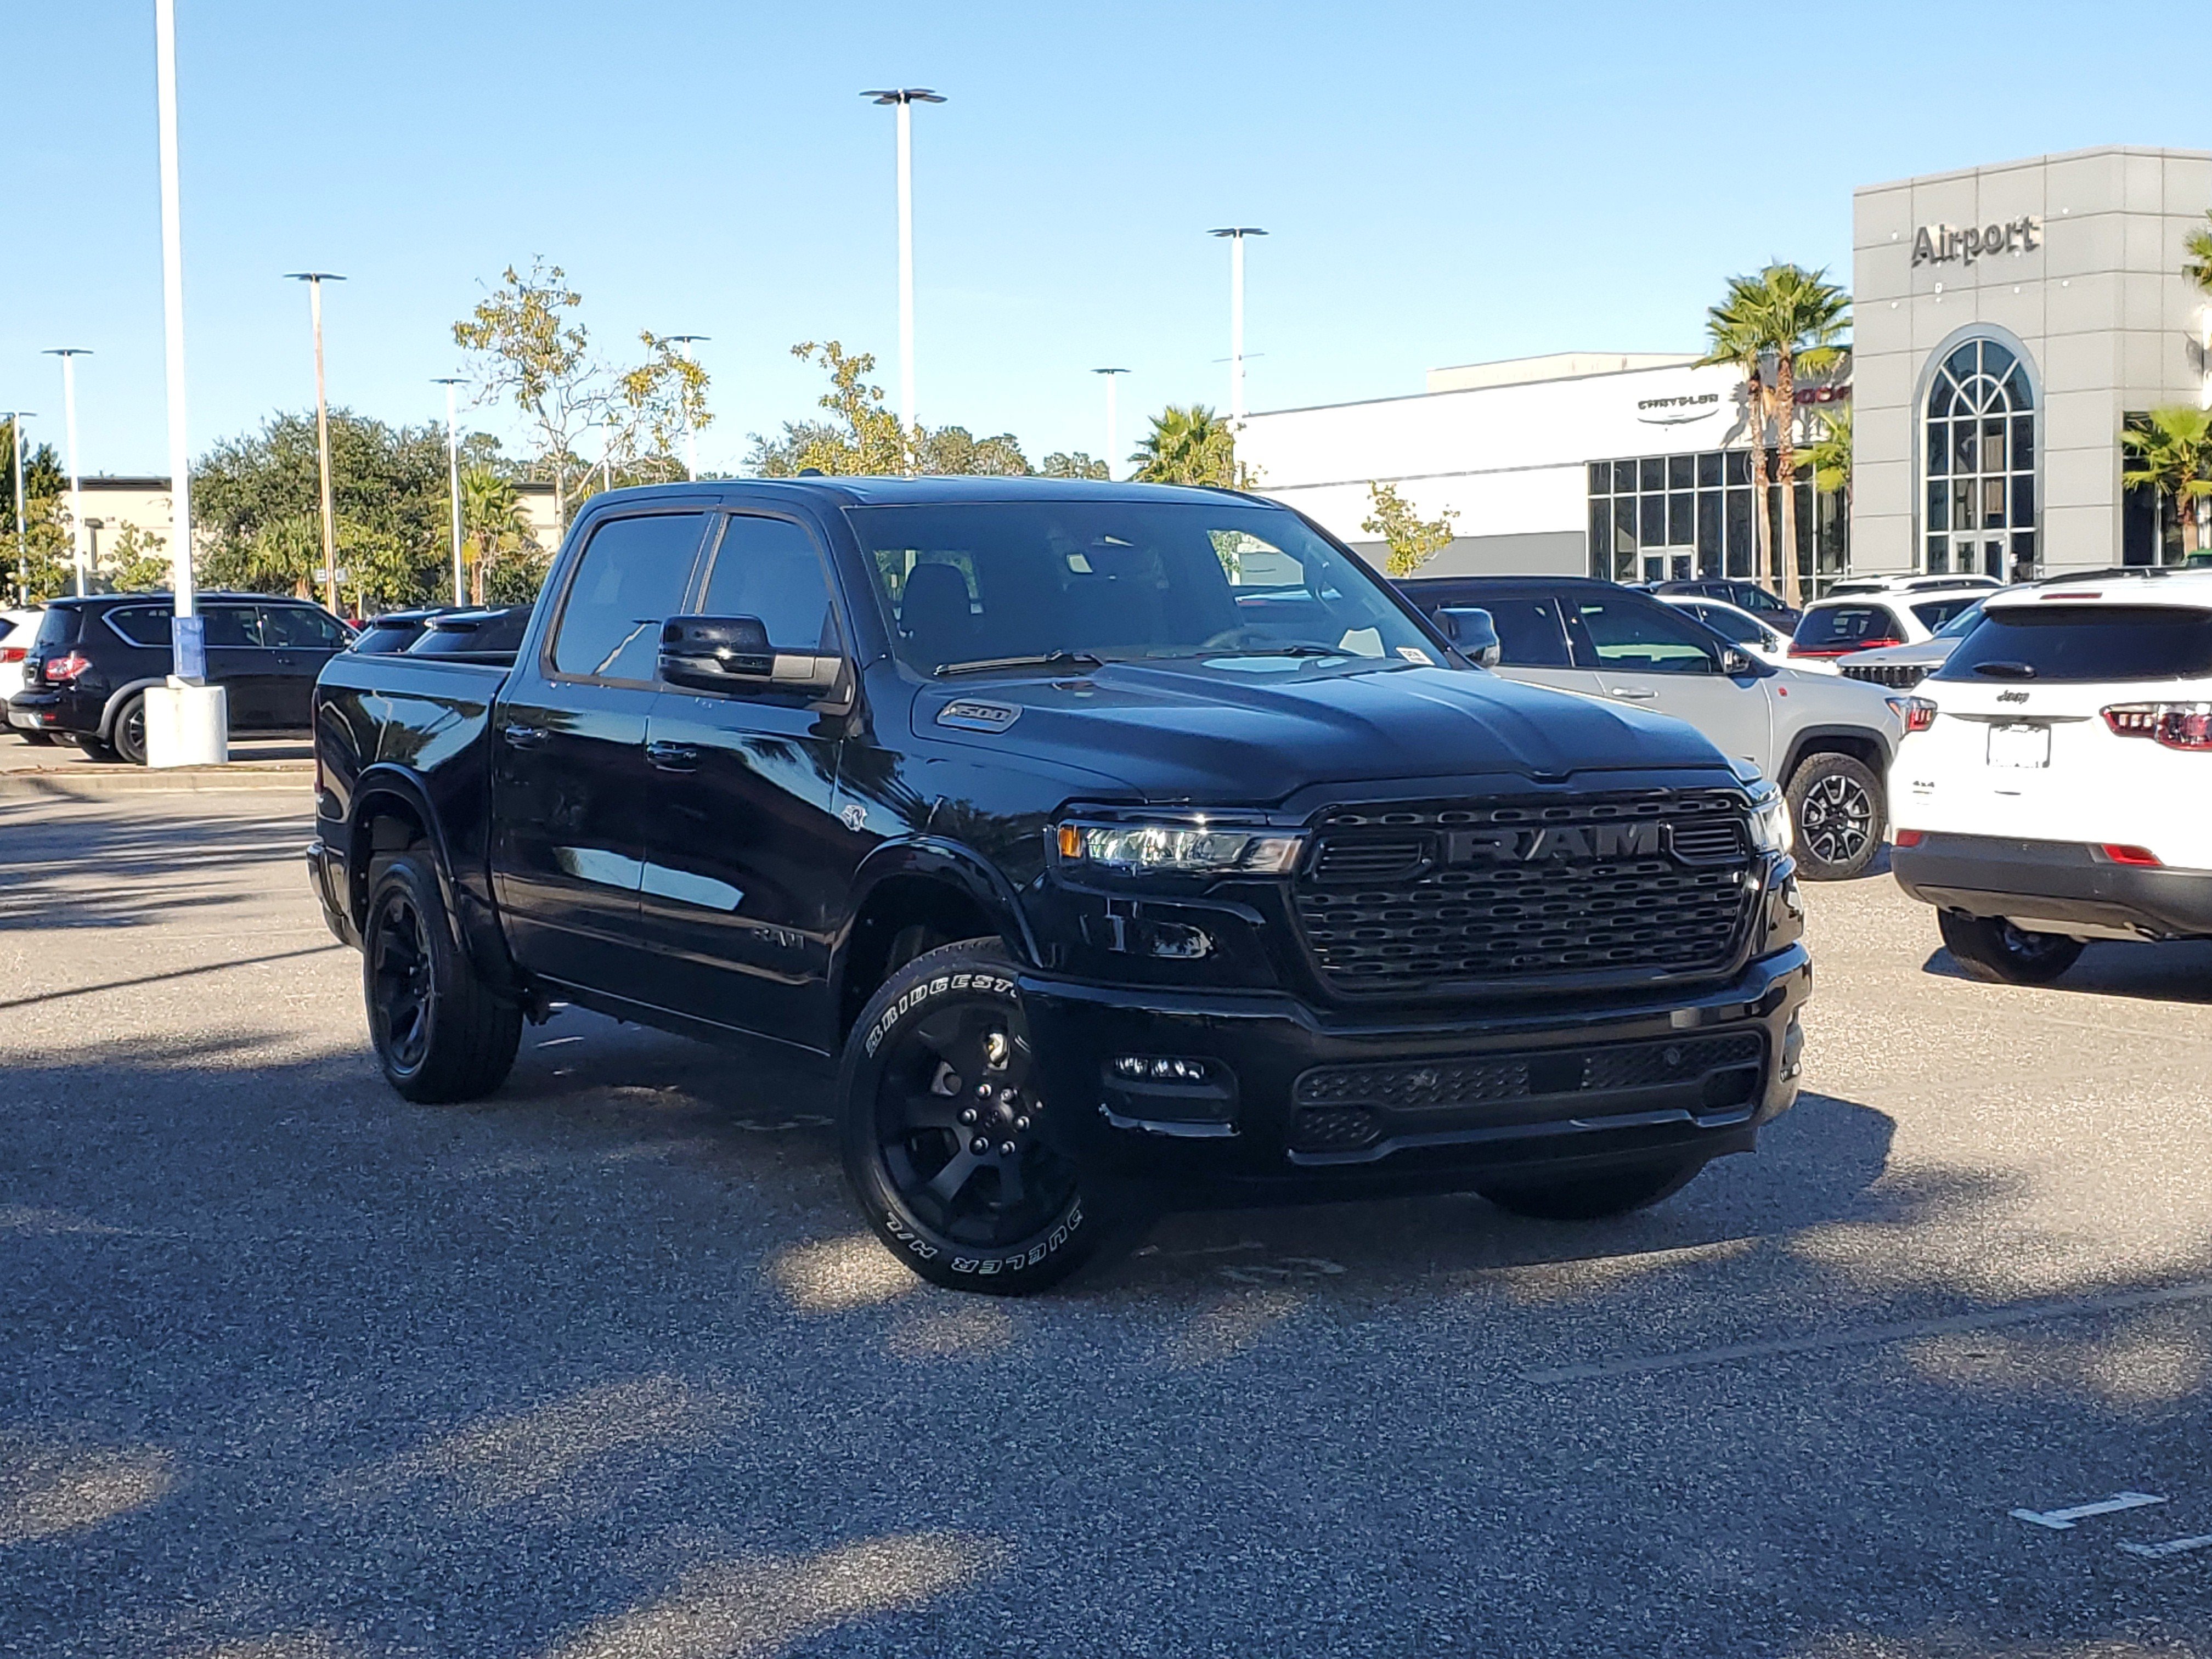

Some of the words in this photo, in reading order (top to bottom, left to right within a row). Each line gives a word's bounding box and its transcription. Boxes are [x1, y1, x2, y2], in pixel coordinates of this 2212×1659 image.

[1912, 216, 2041, 268] Airport
[1638, 393, 1719, 410] CHRYSLER
[1996, 690, 2030, 704] Jeep
[1448, 823, 1660, 863] RAM
[751, 928, 806, 949] RAM
[865, 974, 1018, 1059] BRIDGEST
[951, 1209, 1084, 1274] DUELER
